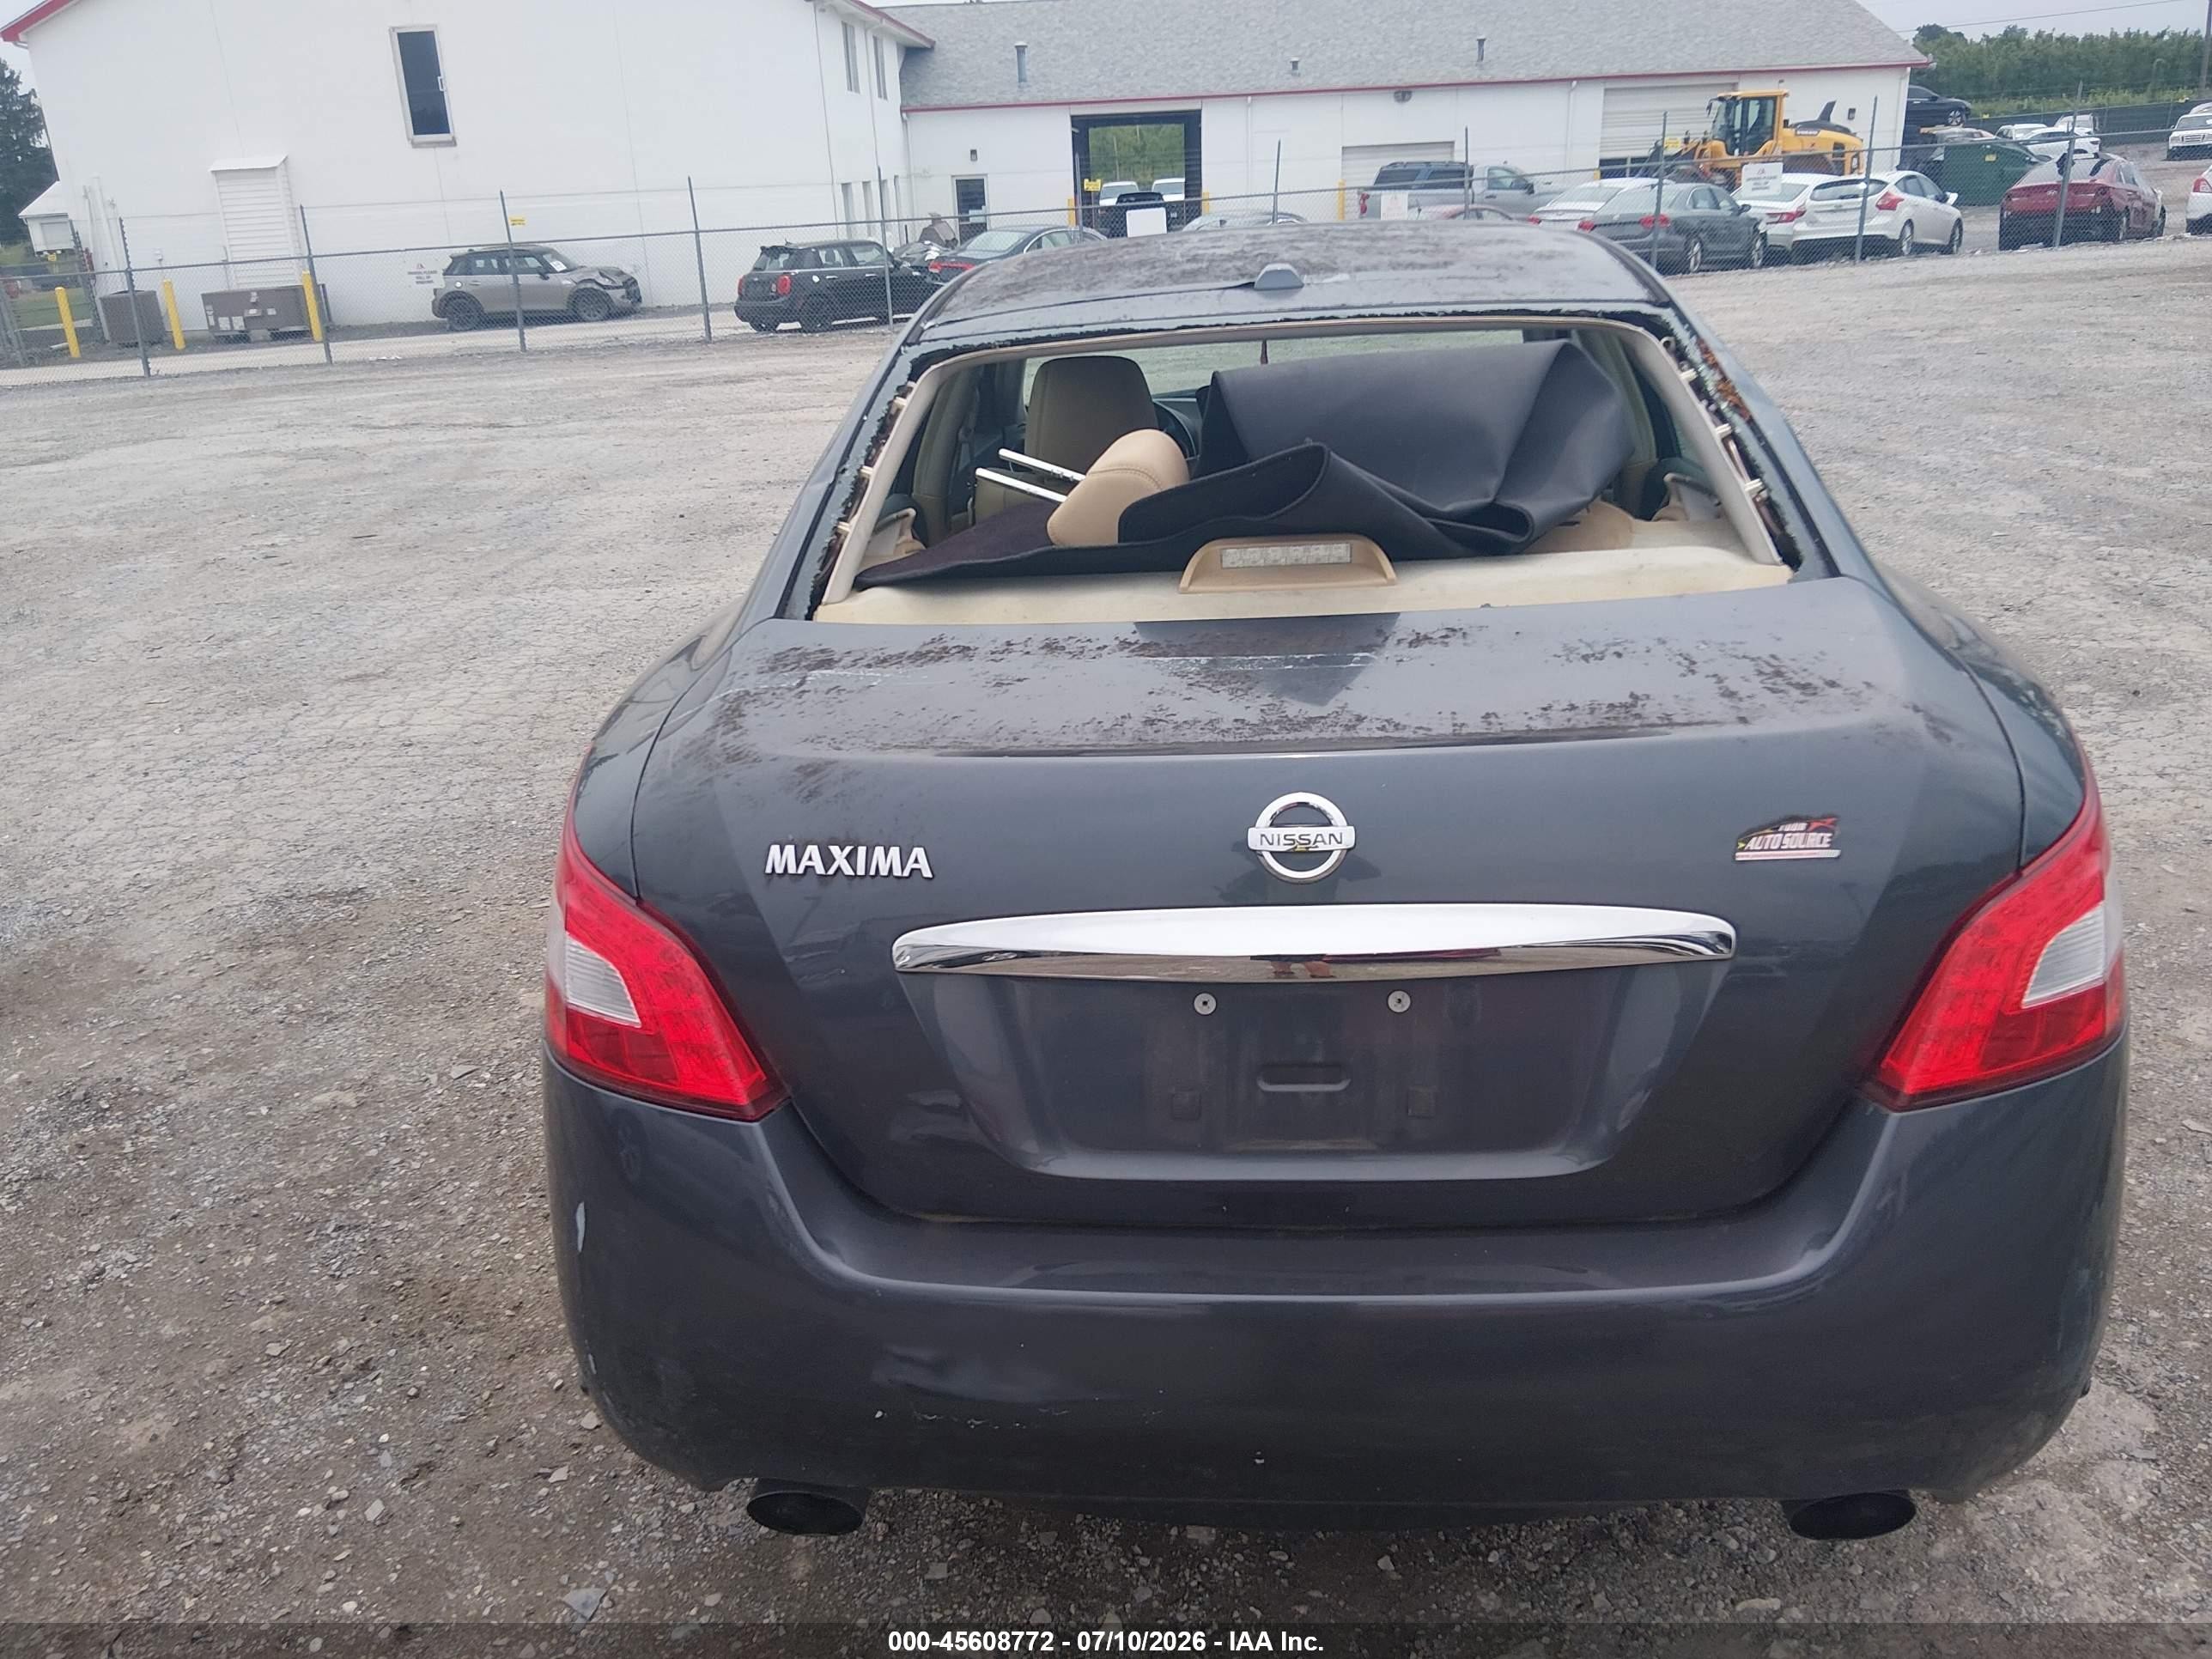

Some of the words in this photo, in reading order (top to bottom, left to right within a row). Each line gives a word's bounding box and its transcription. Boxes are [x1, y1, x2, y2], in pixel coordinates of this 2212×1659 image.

[1260, 831, 1343, 847] NISSAN
[1745, 833, 1784, 850] AUTO
[1781, 832, 1832, 849] SOURCE
[765, 843, 934, 878] MAXIMA
